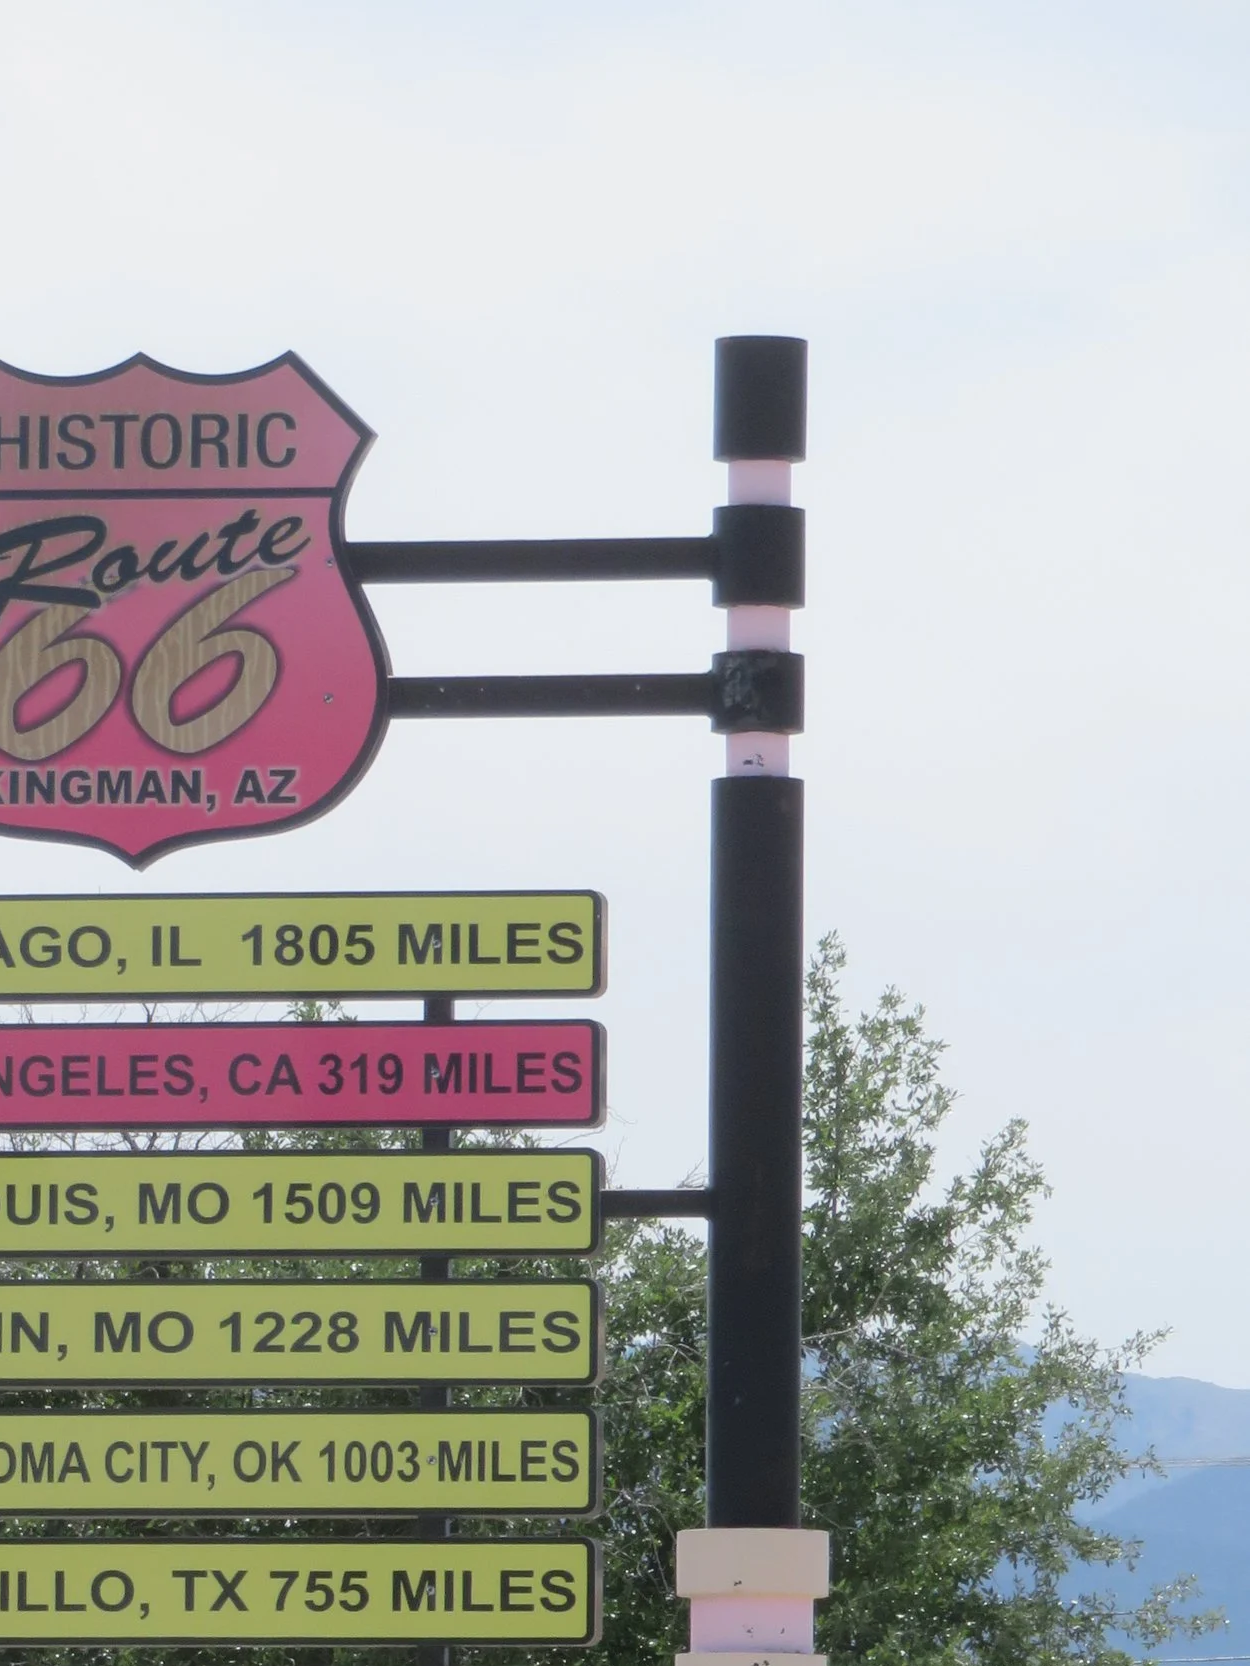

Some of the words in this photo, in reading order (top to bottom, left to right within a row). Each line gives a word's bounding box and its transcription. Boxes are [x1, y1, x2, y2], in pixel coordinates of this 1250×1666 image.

[234, 769, 296, 804] AZ
[152, 926, 201, 966] IL
[242, 924, 374, 966] 1805
[398, 922, 583, 964] MILES
[229, 1054, 303, 1095] CA
[318, 1053, 403, 1095] 319
[424, 1052, 582, 1094] MILES
[139, 1183, 229, 1224] MO
[253, 1183, 380, 1224] 1509
[404, 1181, 581, 1223] MILES
[95, 1311, 193, 1353] MO
[220, 1312, 359, 1353] 1228
[385, 1311, 580, 1353] MILES
[105, 1441, 215, 1490] CITY,
[234, 1441, 301, 1482] OK
[320, 1441, 420, 1482] 1003
[439, 1440, 579, 1482] MILES
[172, 1571, 248, 1611] TX
[270, 1571, 369, 1612] 755
[392, 1570, 576, 1612] MILES
